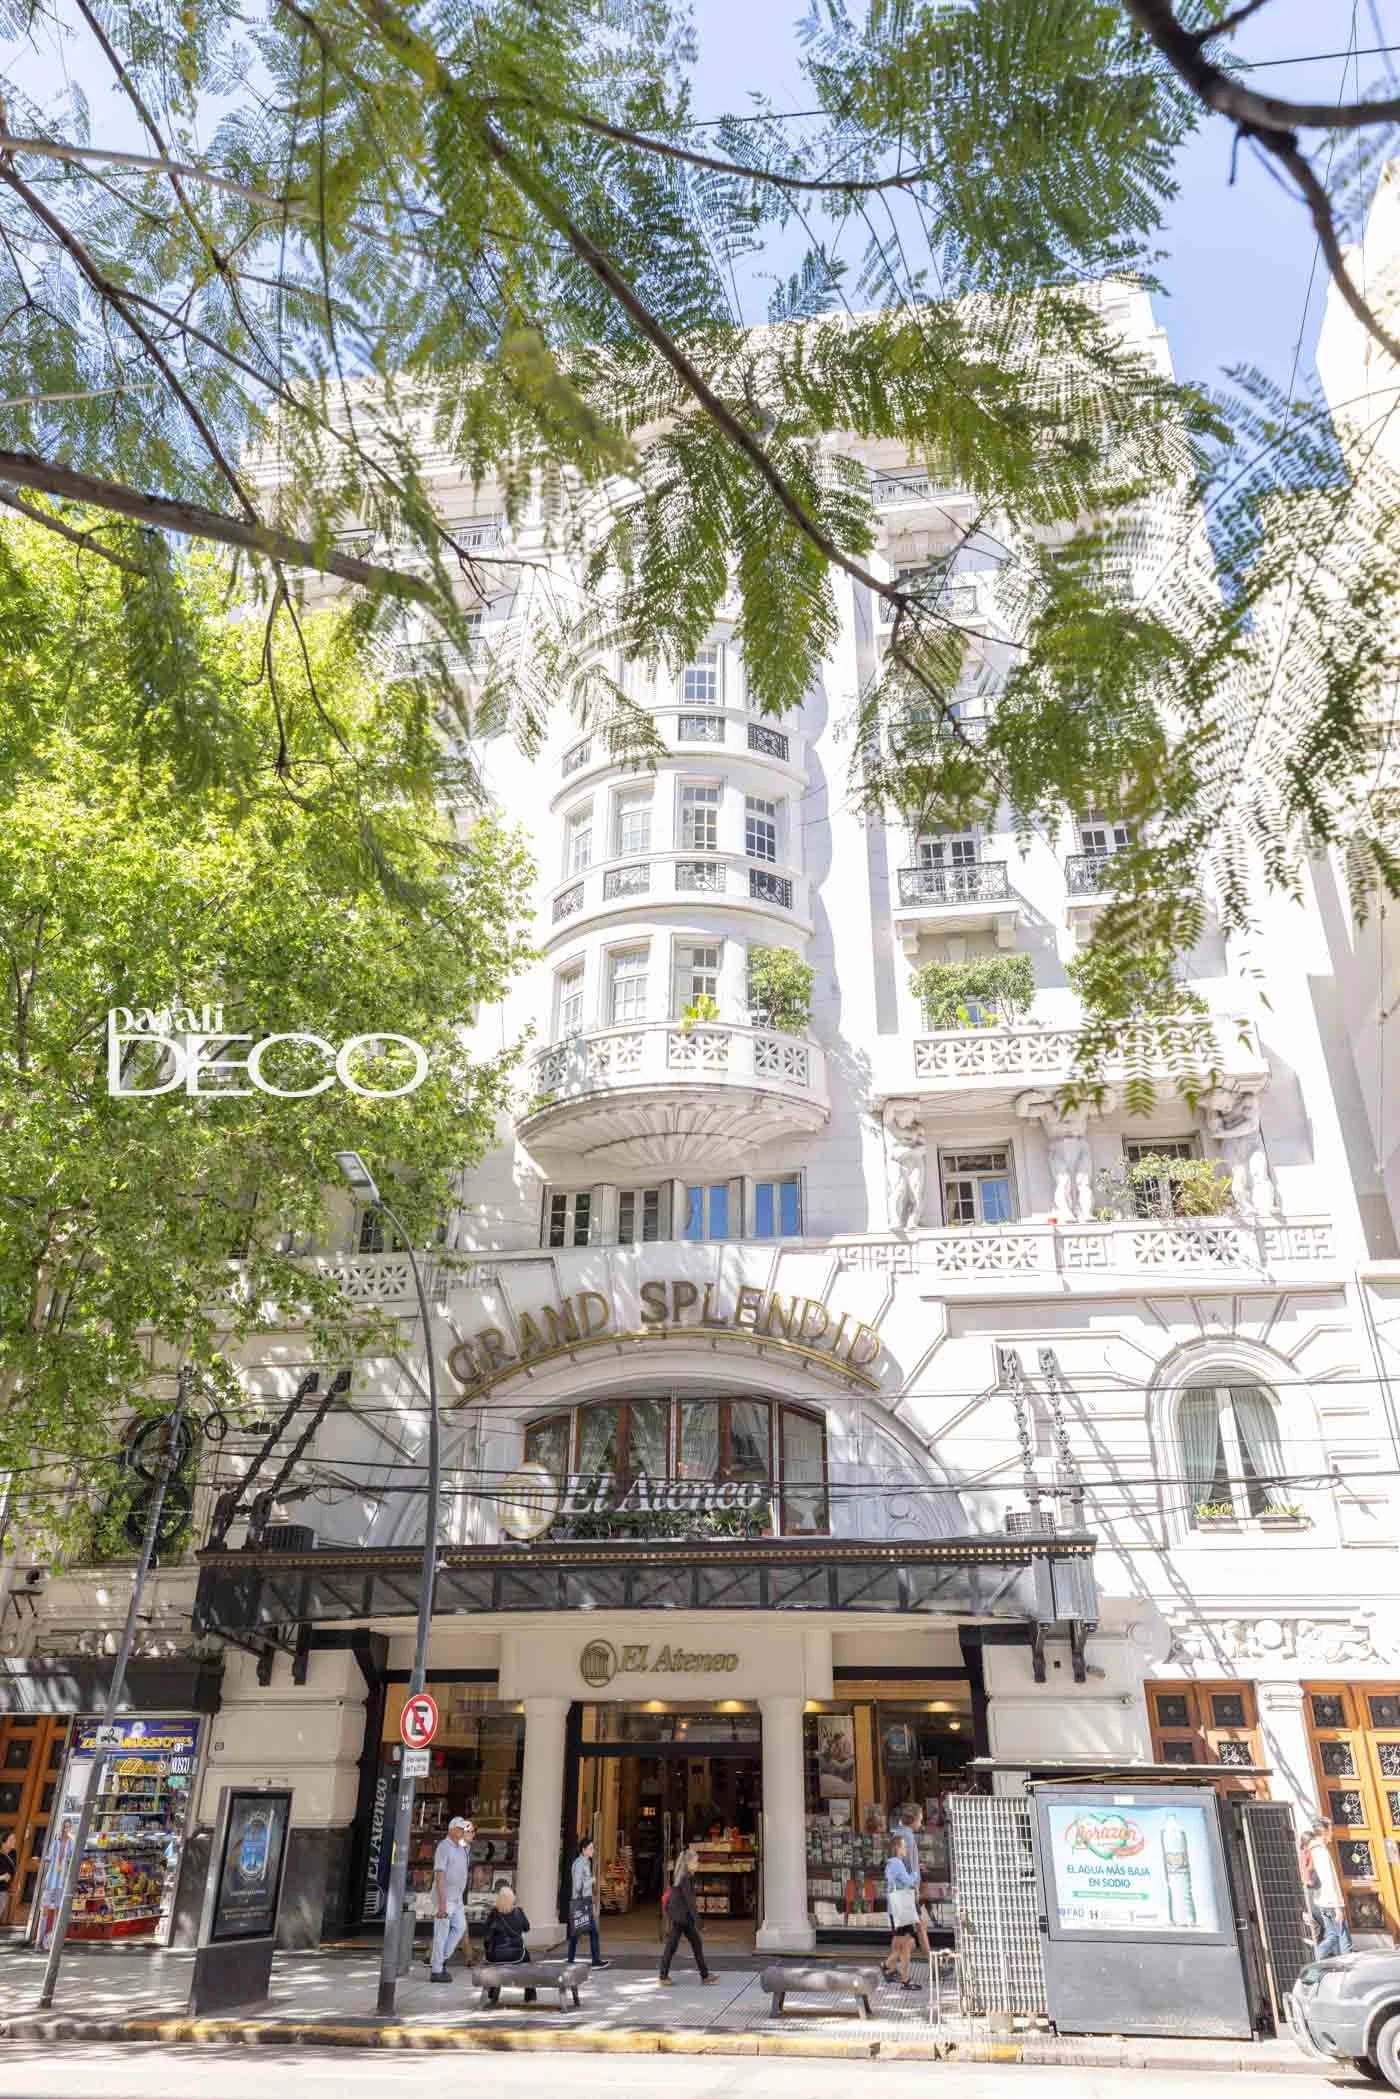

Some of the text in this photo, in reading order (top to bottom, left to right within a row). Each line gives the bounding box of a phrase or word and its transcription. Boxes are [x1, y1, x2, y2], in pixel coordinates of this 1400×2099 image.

[446, 1279, 882, 1386] GRAND SPLENDID
[560, 1471, 763, 1513] El Ateneo
[616, 1644, 739, 1673] El Ateneo
[411, 1705, 429, 1736] E
[367, 1777, 389, 1880] El Ateneo
[1066, 1864, 1151, 1876] EL AGUA MÁS BAJA
[1088, 1878, 1131, 1889] EN SODIO
